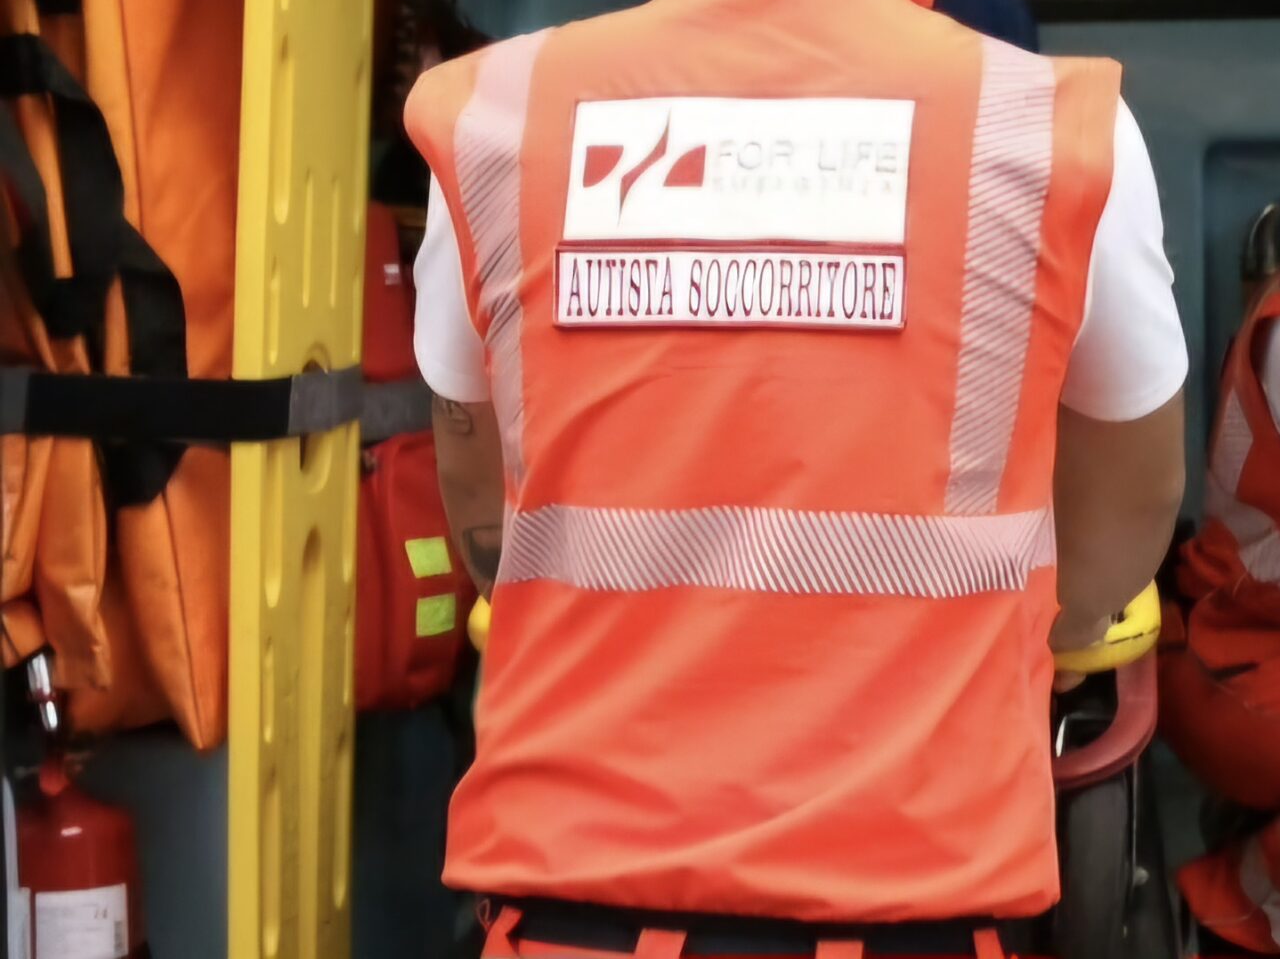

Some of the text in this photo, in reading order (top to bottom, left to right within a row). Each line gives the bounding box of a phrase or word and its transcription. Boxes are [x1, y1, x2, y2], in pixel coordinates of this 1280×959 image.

[715, 138, 897, 173] FOR LIFE
[566, 256, 674, 317] AUTISTA
